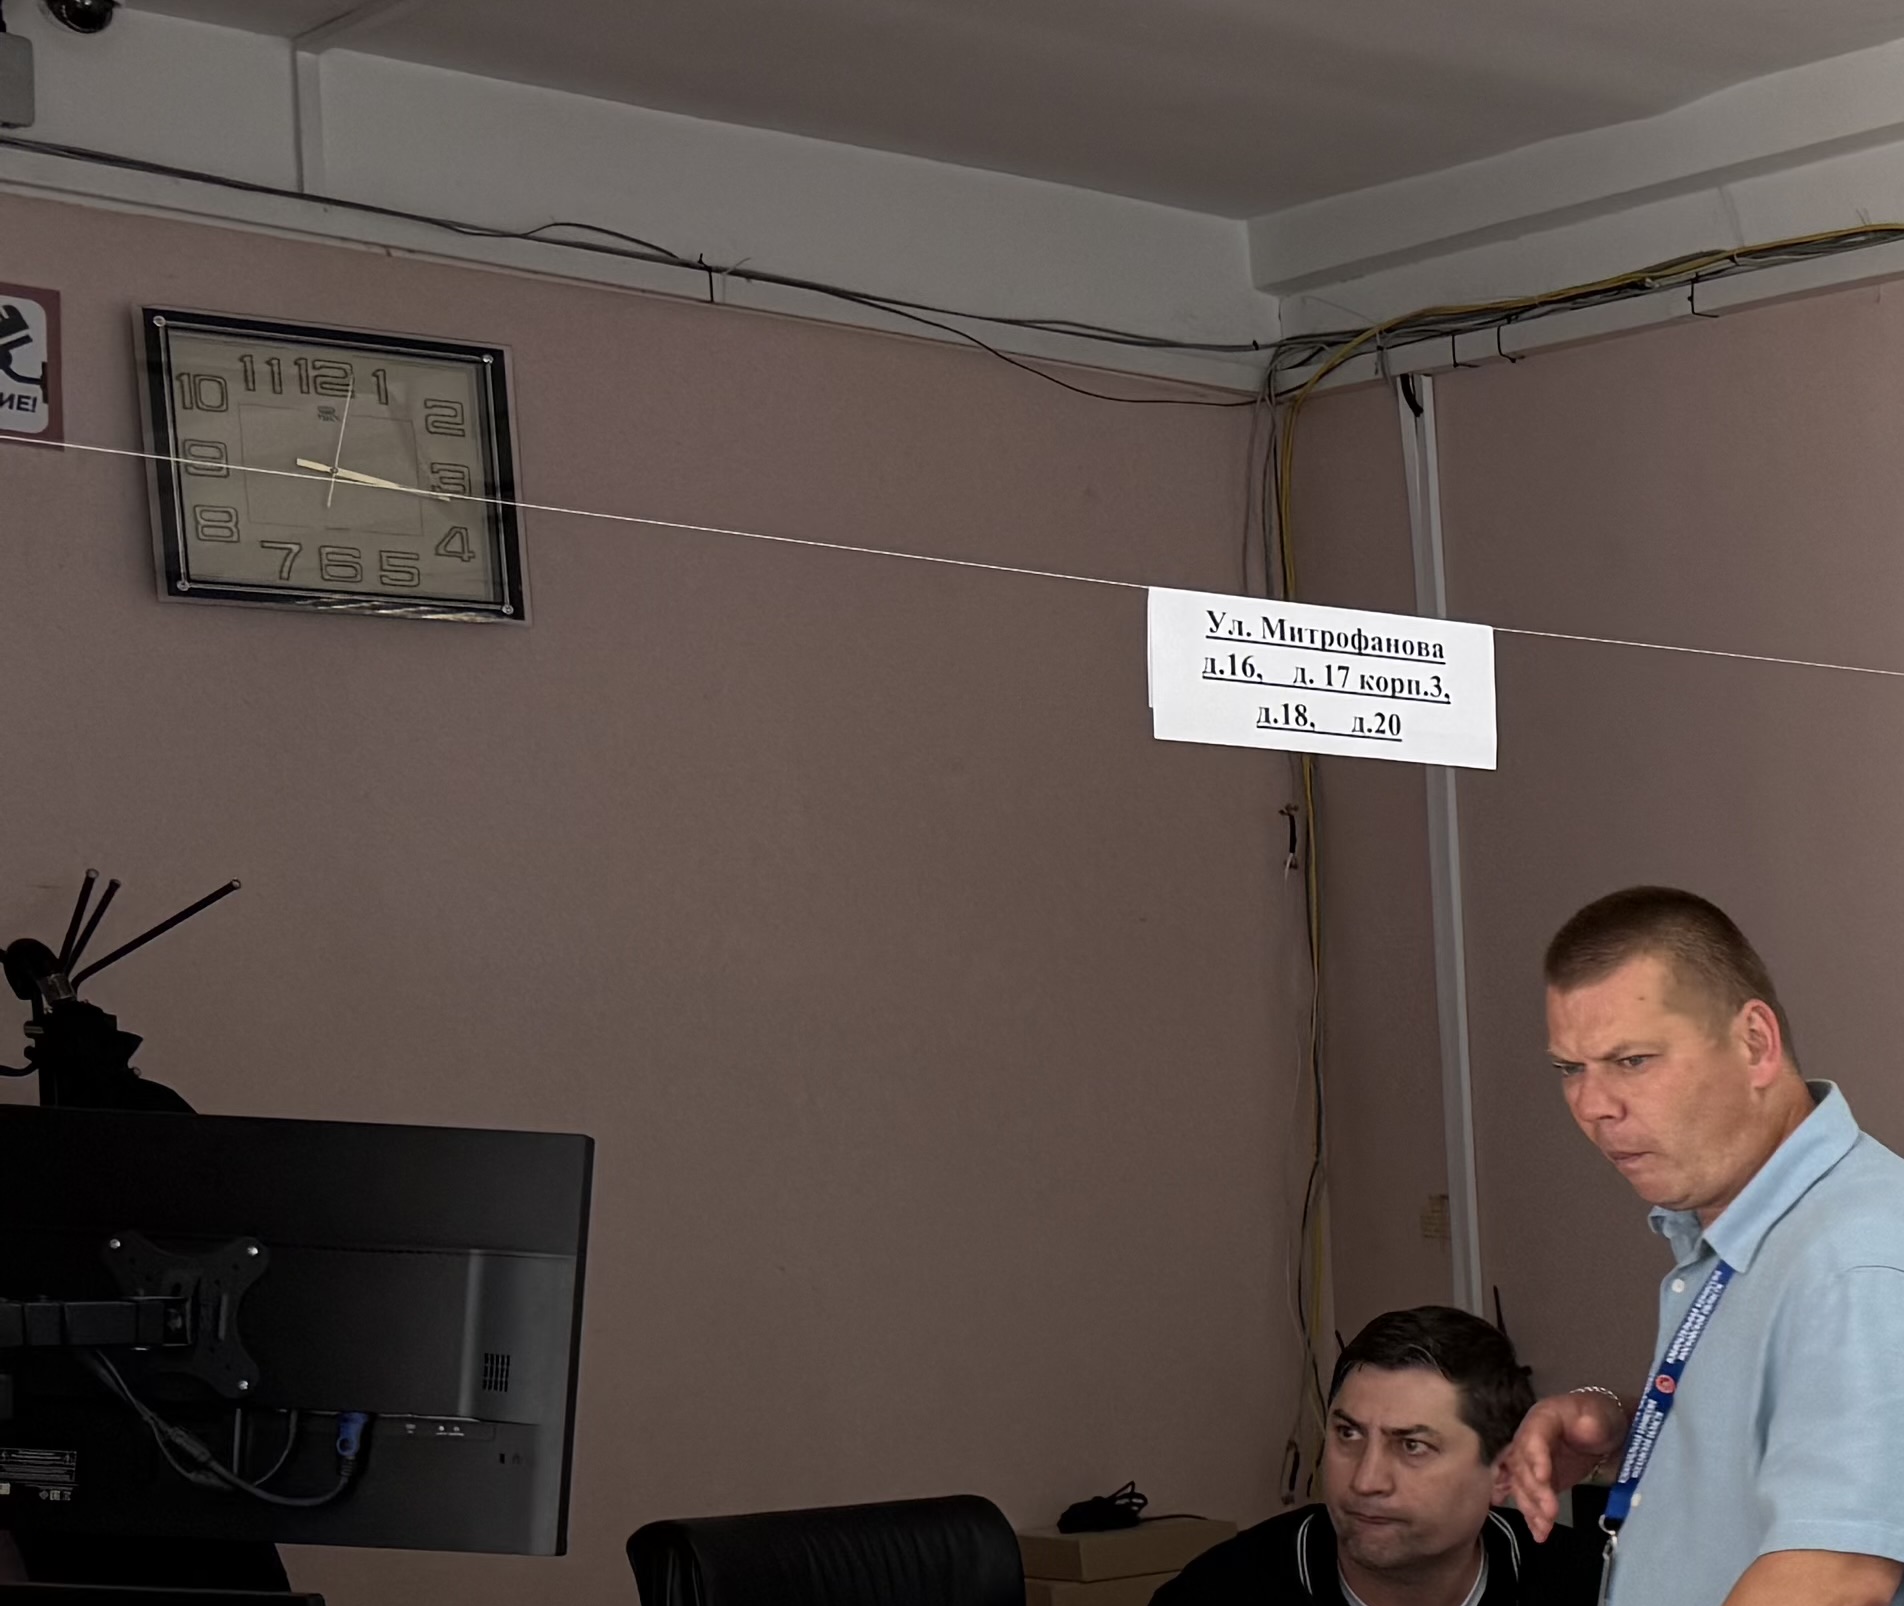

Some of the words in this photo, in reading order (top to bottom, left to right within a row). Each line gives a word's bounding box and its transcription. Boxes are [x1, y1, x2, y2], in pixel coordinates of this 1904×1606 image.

[176, 372, 229, 412] 10
[240, 354, 284, 394] 11
[294, 357, 356, 398] 12
[371, 368, 390, 405] 1
[424, 398, 466, 437] 2
[183, 438, 229, 478] 9
[430, 462, 471, 500] 3
[194, 504, 240, 543] 8
[260, 540, 303, 581] 7
[318, 545, 364, 584] 6
[379, 550, 421, 588] 5
[435, 526, 476, 562] 4
[1206, 609, 1252, 638] Ул.
[1261, 615, 1445, 660] Митрофанова
[1202, 653, 1264, 682] д.16,
[1292, 665, 1315, 687] д.
[1324, 663, 1351, 689] 17
[1359, 674, 1452, 703] корп.3,
[1256, 703, 1316, 730] д.18,
[1351, 712, 1402, 738] д.20
